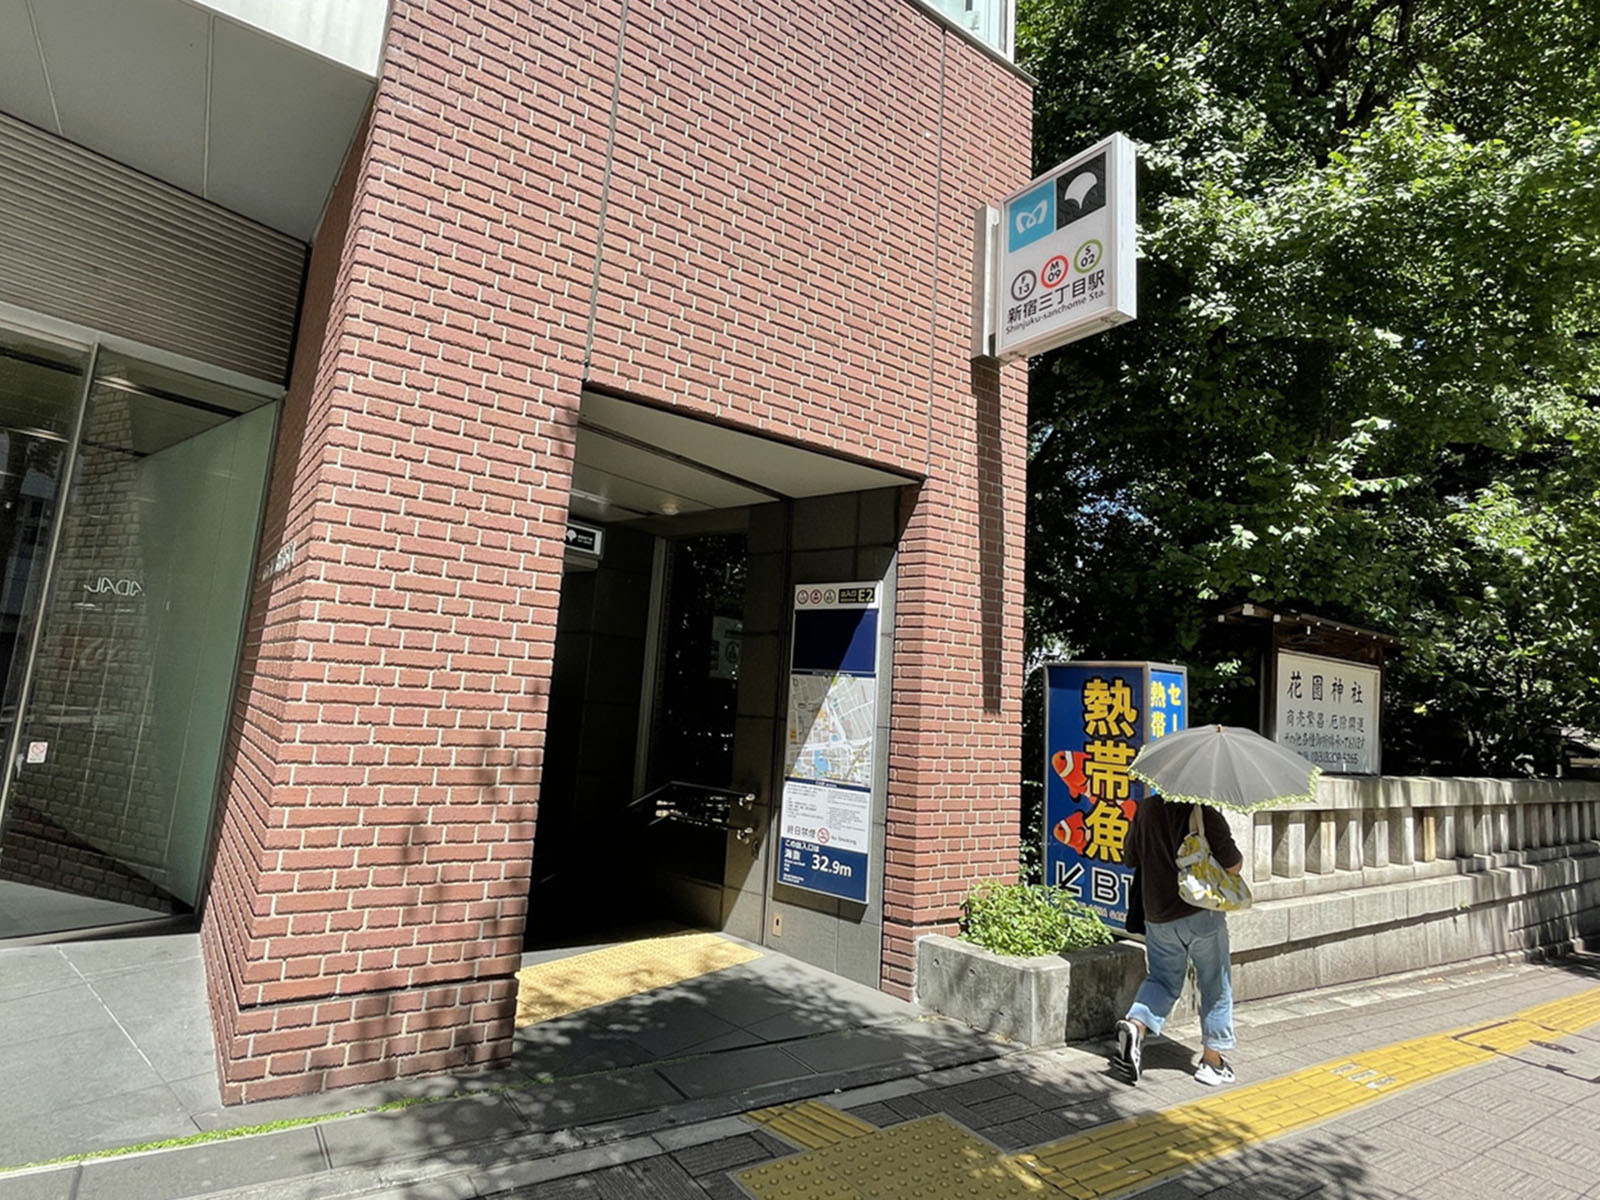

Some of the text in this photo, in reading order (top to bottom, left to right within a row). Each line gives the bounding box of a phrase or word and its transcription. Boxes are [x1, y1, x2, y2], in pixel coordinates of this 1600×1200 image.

[1084, 245, 1091, 255] S
[1050, 261, 1060, 271] M
[1080, 253, 1095, 267] 02
[1021, 275, 1027, 284] F
[1047, 269, 1062, 282] 09
[1007, 269, 1105, 323] 新宿三丁目駅
[1018, 283, 1030, 295] 13
[1005, 297, 1087, 334] Shinjuku-sanchome
[858, 588, 873, 602] E2
[1286, 670, 1364, 704] 花園神社
[1083, 679, 1138, 862] 熱帯魚
[811, 854, 852, 877] 32.9m
